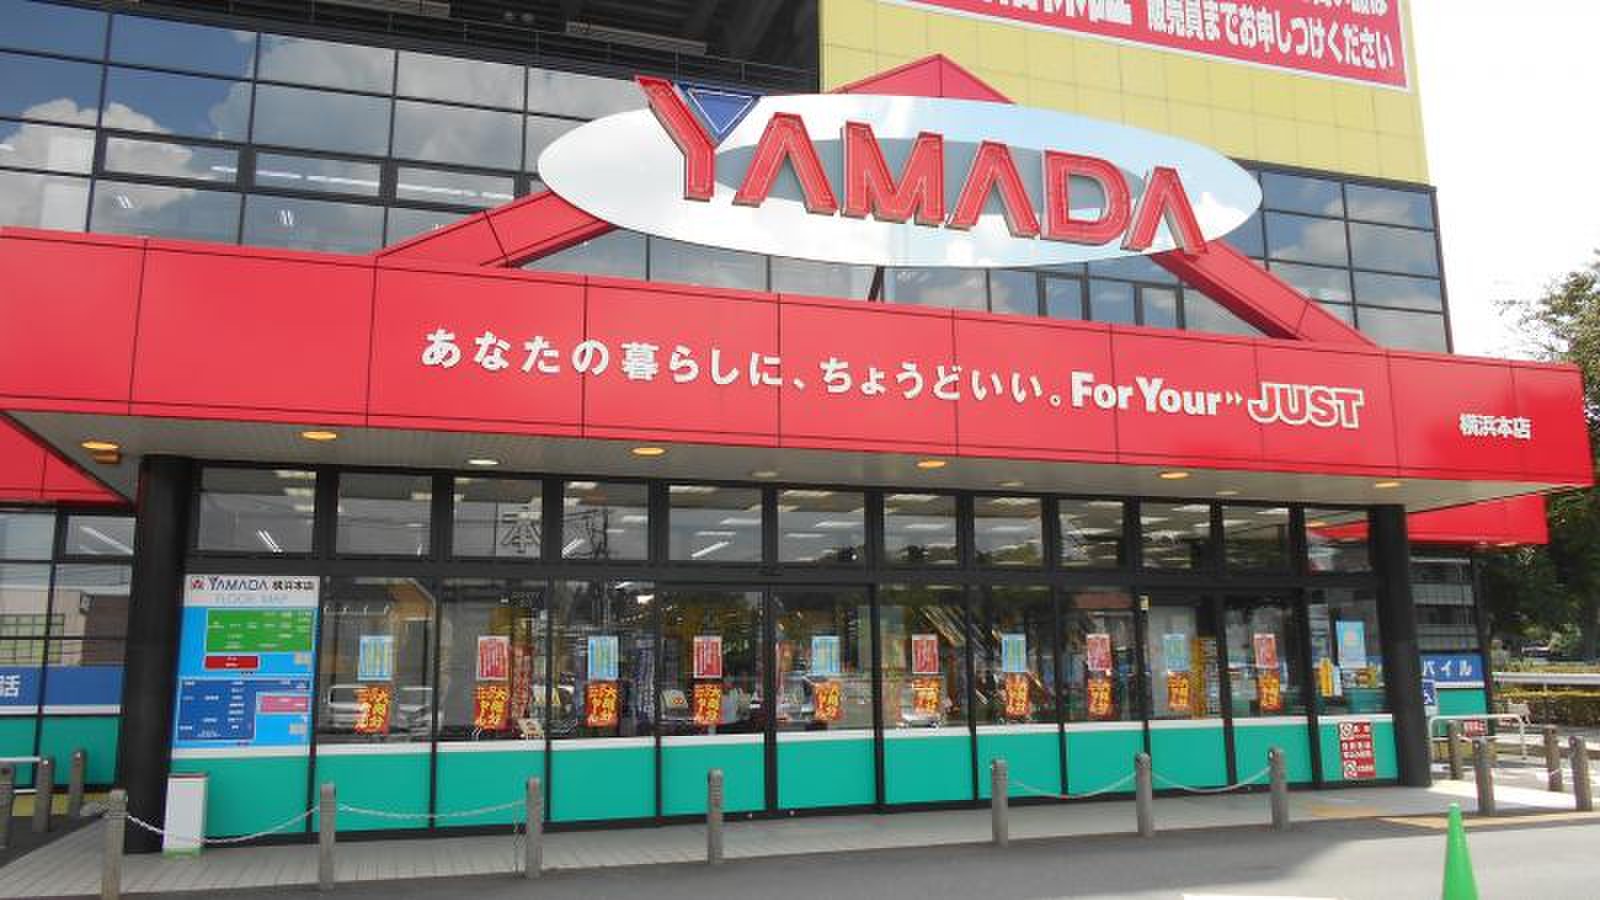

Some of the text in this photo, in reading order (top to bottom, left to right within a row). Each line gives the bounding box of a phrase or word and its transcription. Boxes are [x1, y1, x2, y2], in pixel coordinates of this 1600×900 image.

[634, 74, 1208, 254] YAMADA
[421, 328, 1364, 429] あなたの暮らしに、ちょうどいい。 For Your JUST
[1459, 413, 1532, 440] 横浜本店
[209, 576, 269, 591] YAMADA
